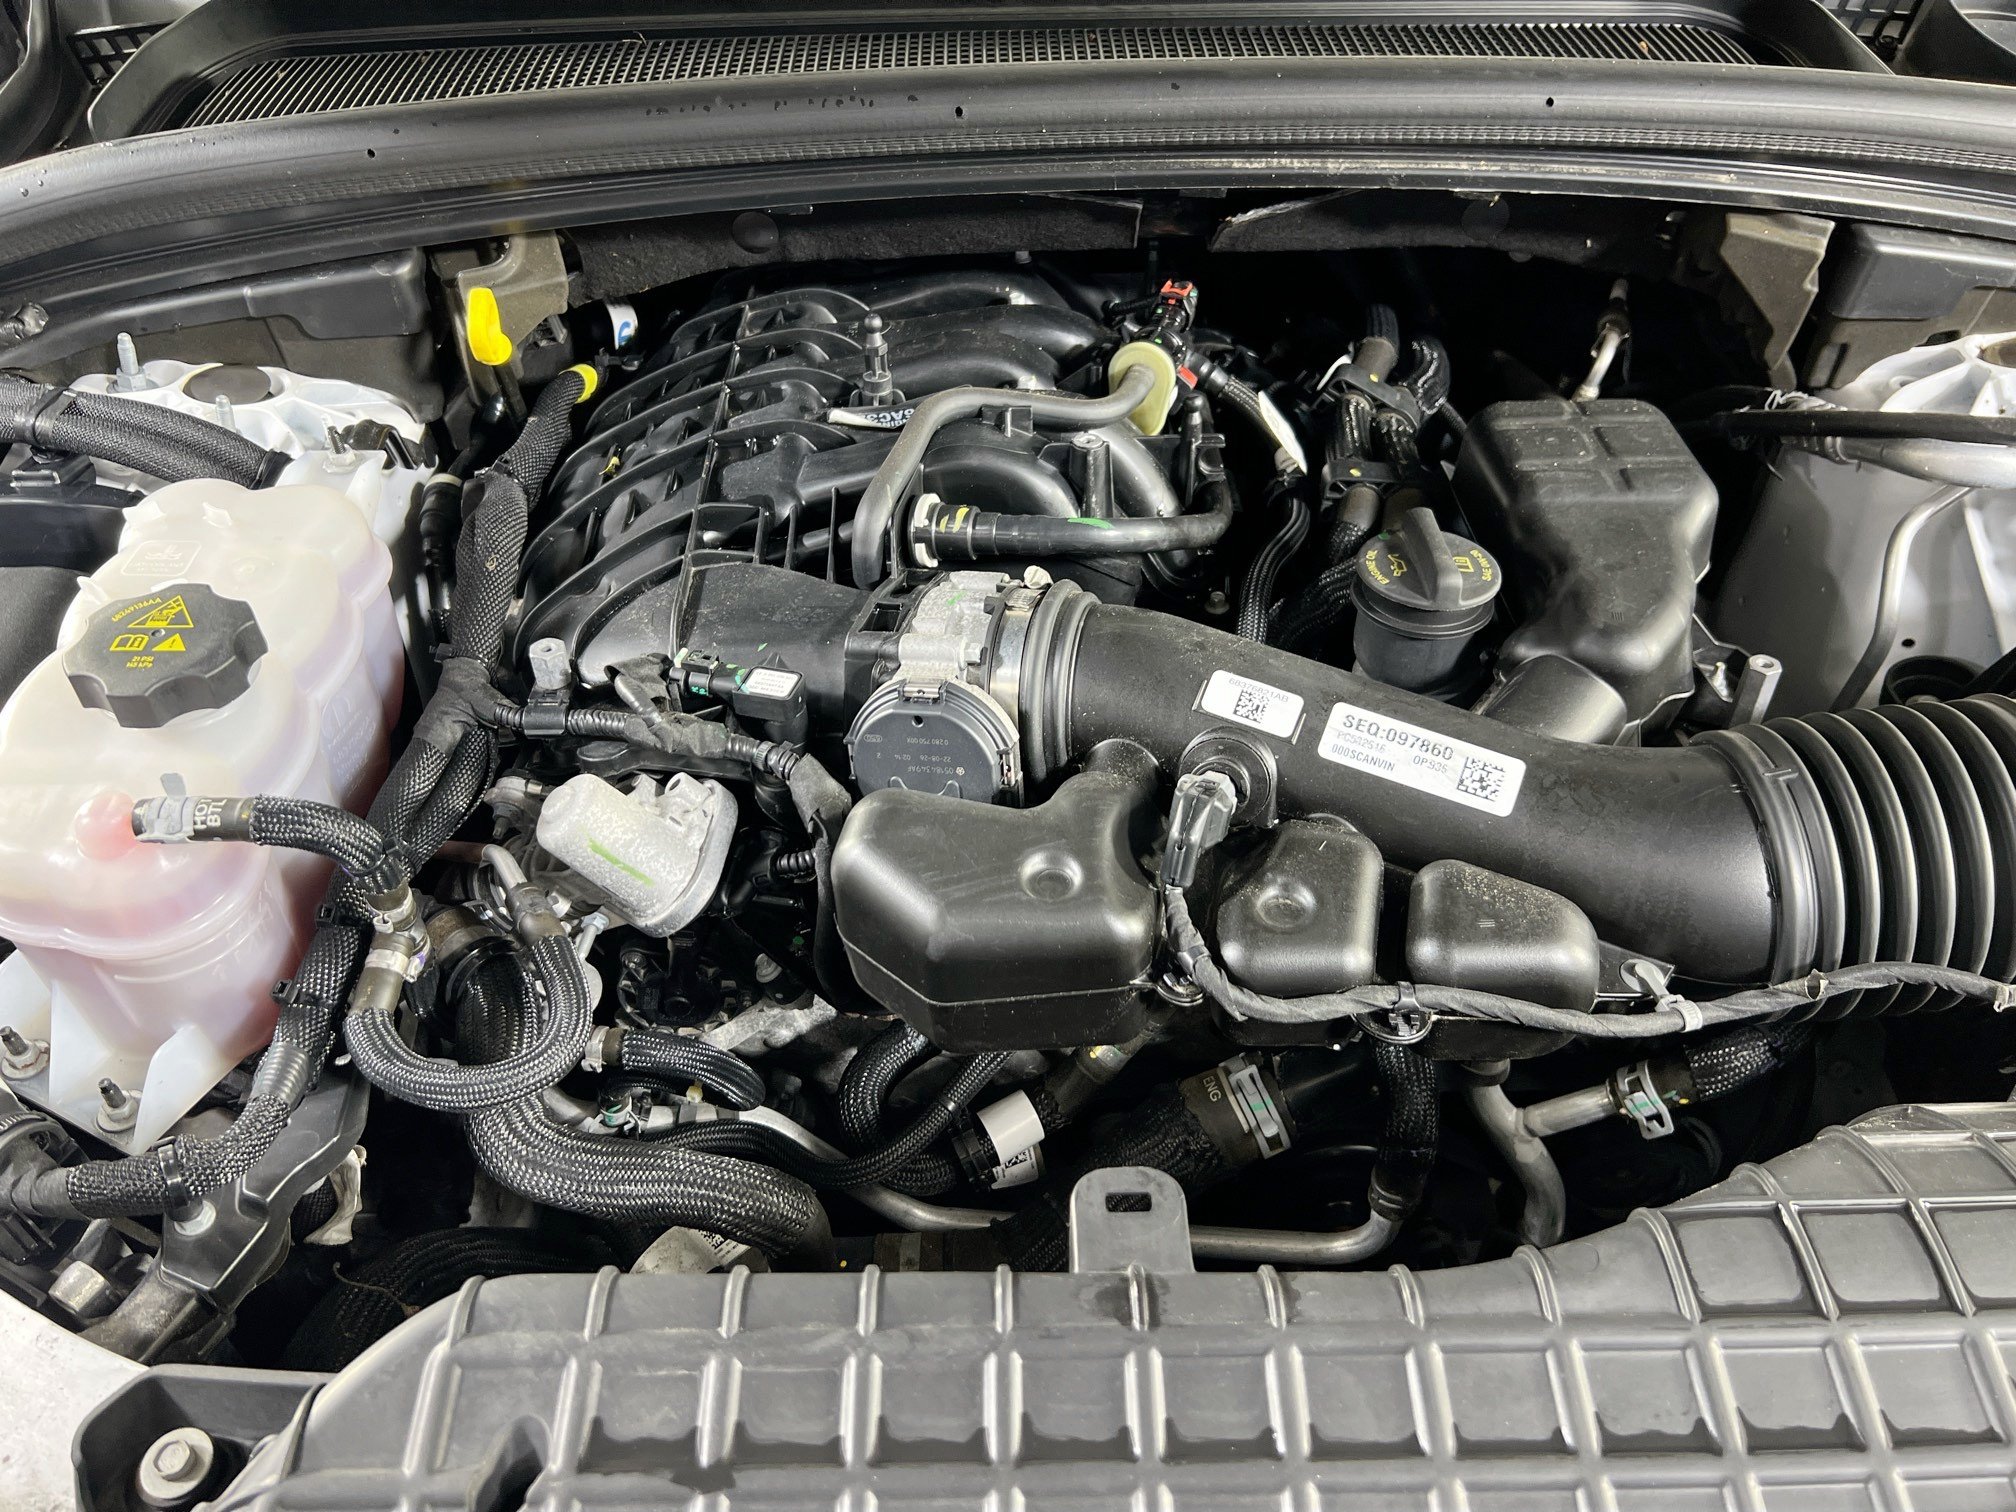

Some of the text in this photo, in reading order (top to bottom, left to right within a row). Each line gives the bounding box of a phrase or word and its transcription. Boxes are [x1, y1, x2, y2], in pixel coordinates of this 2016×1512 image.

[1342, 714, 1454, 761] SEQ:097860
[206, 798, 228, 828] BTL
[1202, 1075, 1222, 1102] ENG
